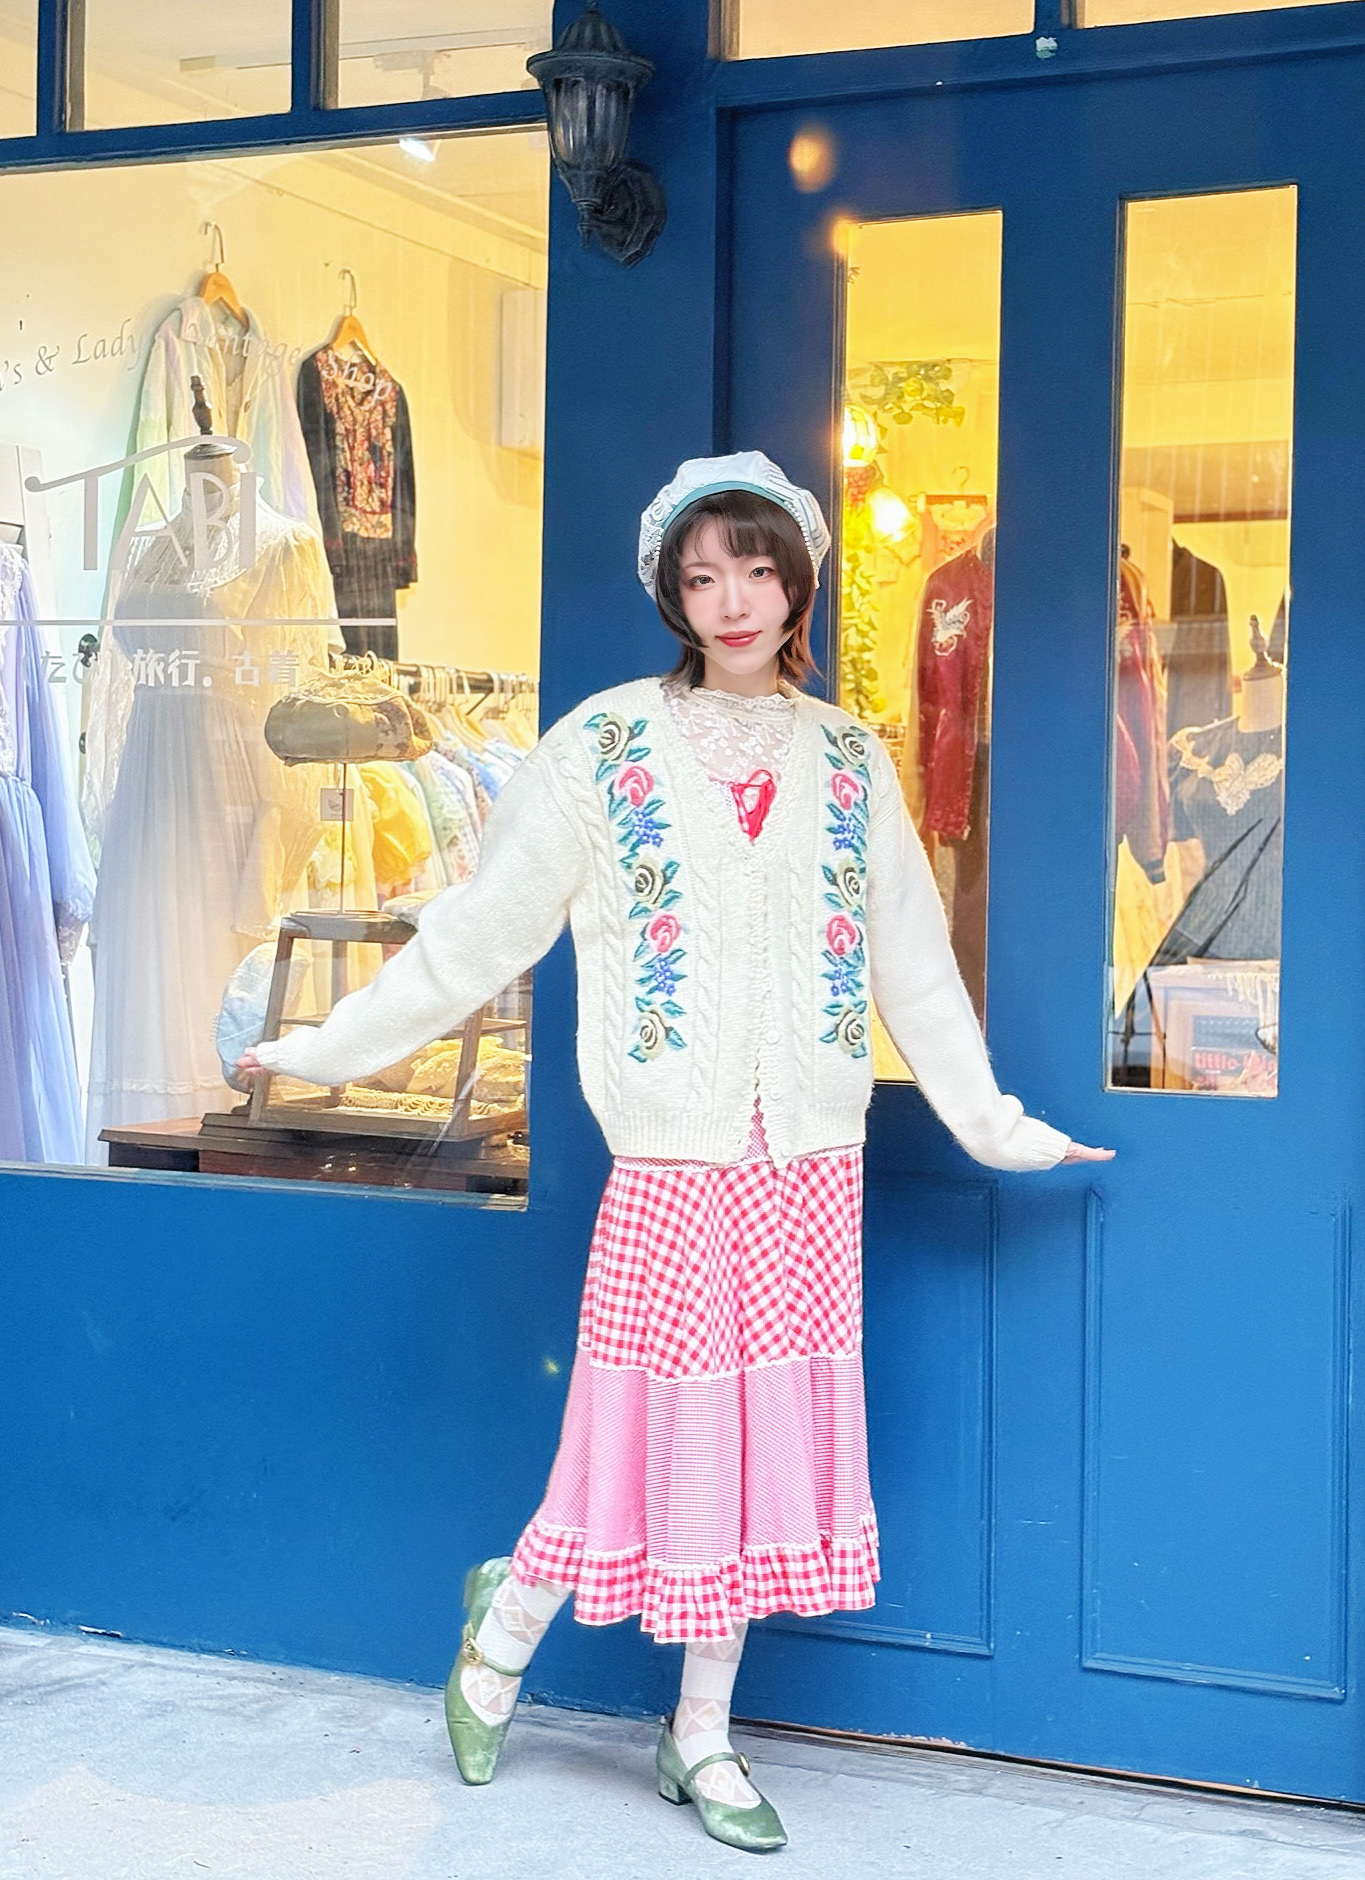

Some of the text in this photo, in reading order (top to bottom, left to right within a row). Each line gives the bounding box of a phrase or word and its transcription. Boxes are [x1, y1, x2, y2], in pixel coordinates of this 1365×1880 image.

[35, 345, 60, 376] &
[322, 350, 392, 405] Shop
[24, 434, 257, 571] TABI
[232, 649, 300, 687] 古着
